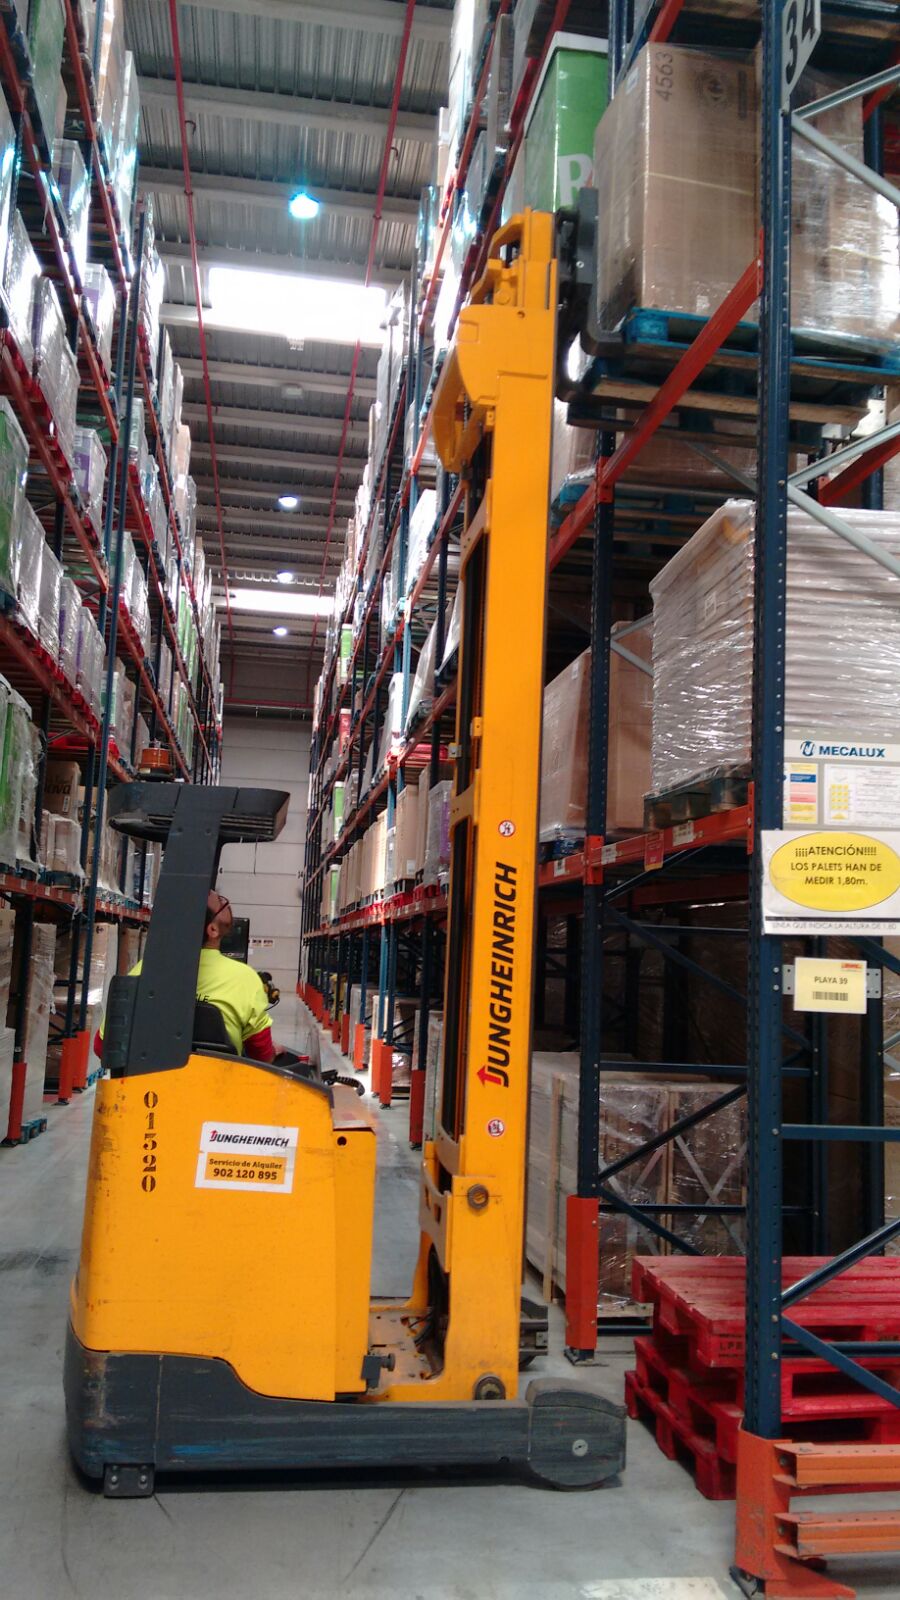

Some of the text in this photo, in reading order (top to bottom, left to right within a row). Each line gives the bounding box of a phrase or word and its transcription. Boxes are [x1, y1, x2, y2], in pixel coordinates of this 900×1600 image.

[655, 51, 674, 102] 4563
[818, 745, 886, 758] MECALUX
[790, 862, 882, 872] LOS PALETS HAN DE
[804, 876, 834, 885] MEDIR
[487, 861, 517, 1088] JUNGHEINRICH
[814, 976, 838, 984] PLAYA
[141, 1091, 159, 1192] 01520
[209, 1131, 290, 1148] JUNGHEINRICH
[208, 1158, 282, 1170] Servicio de Alquiler
[213, 1168, 278, 1180] 902 120 895
